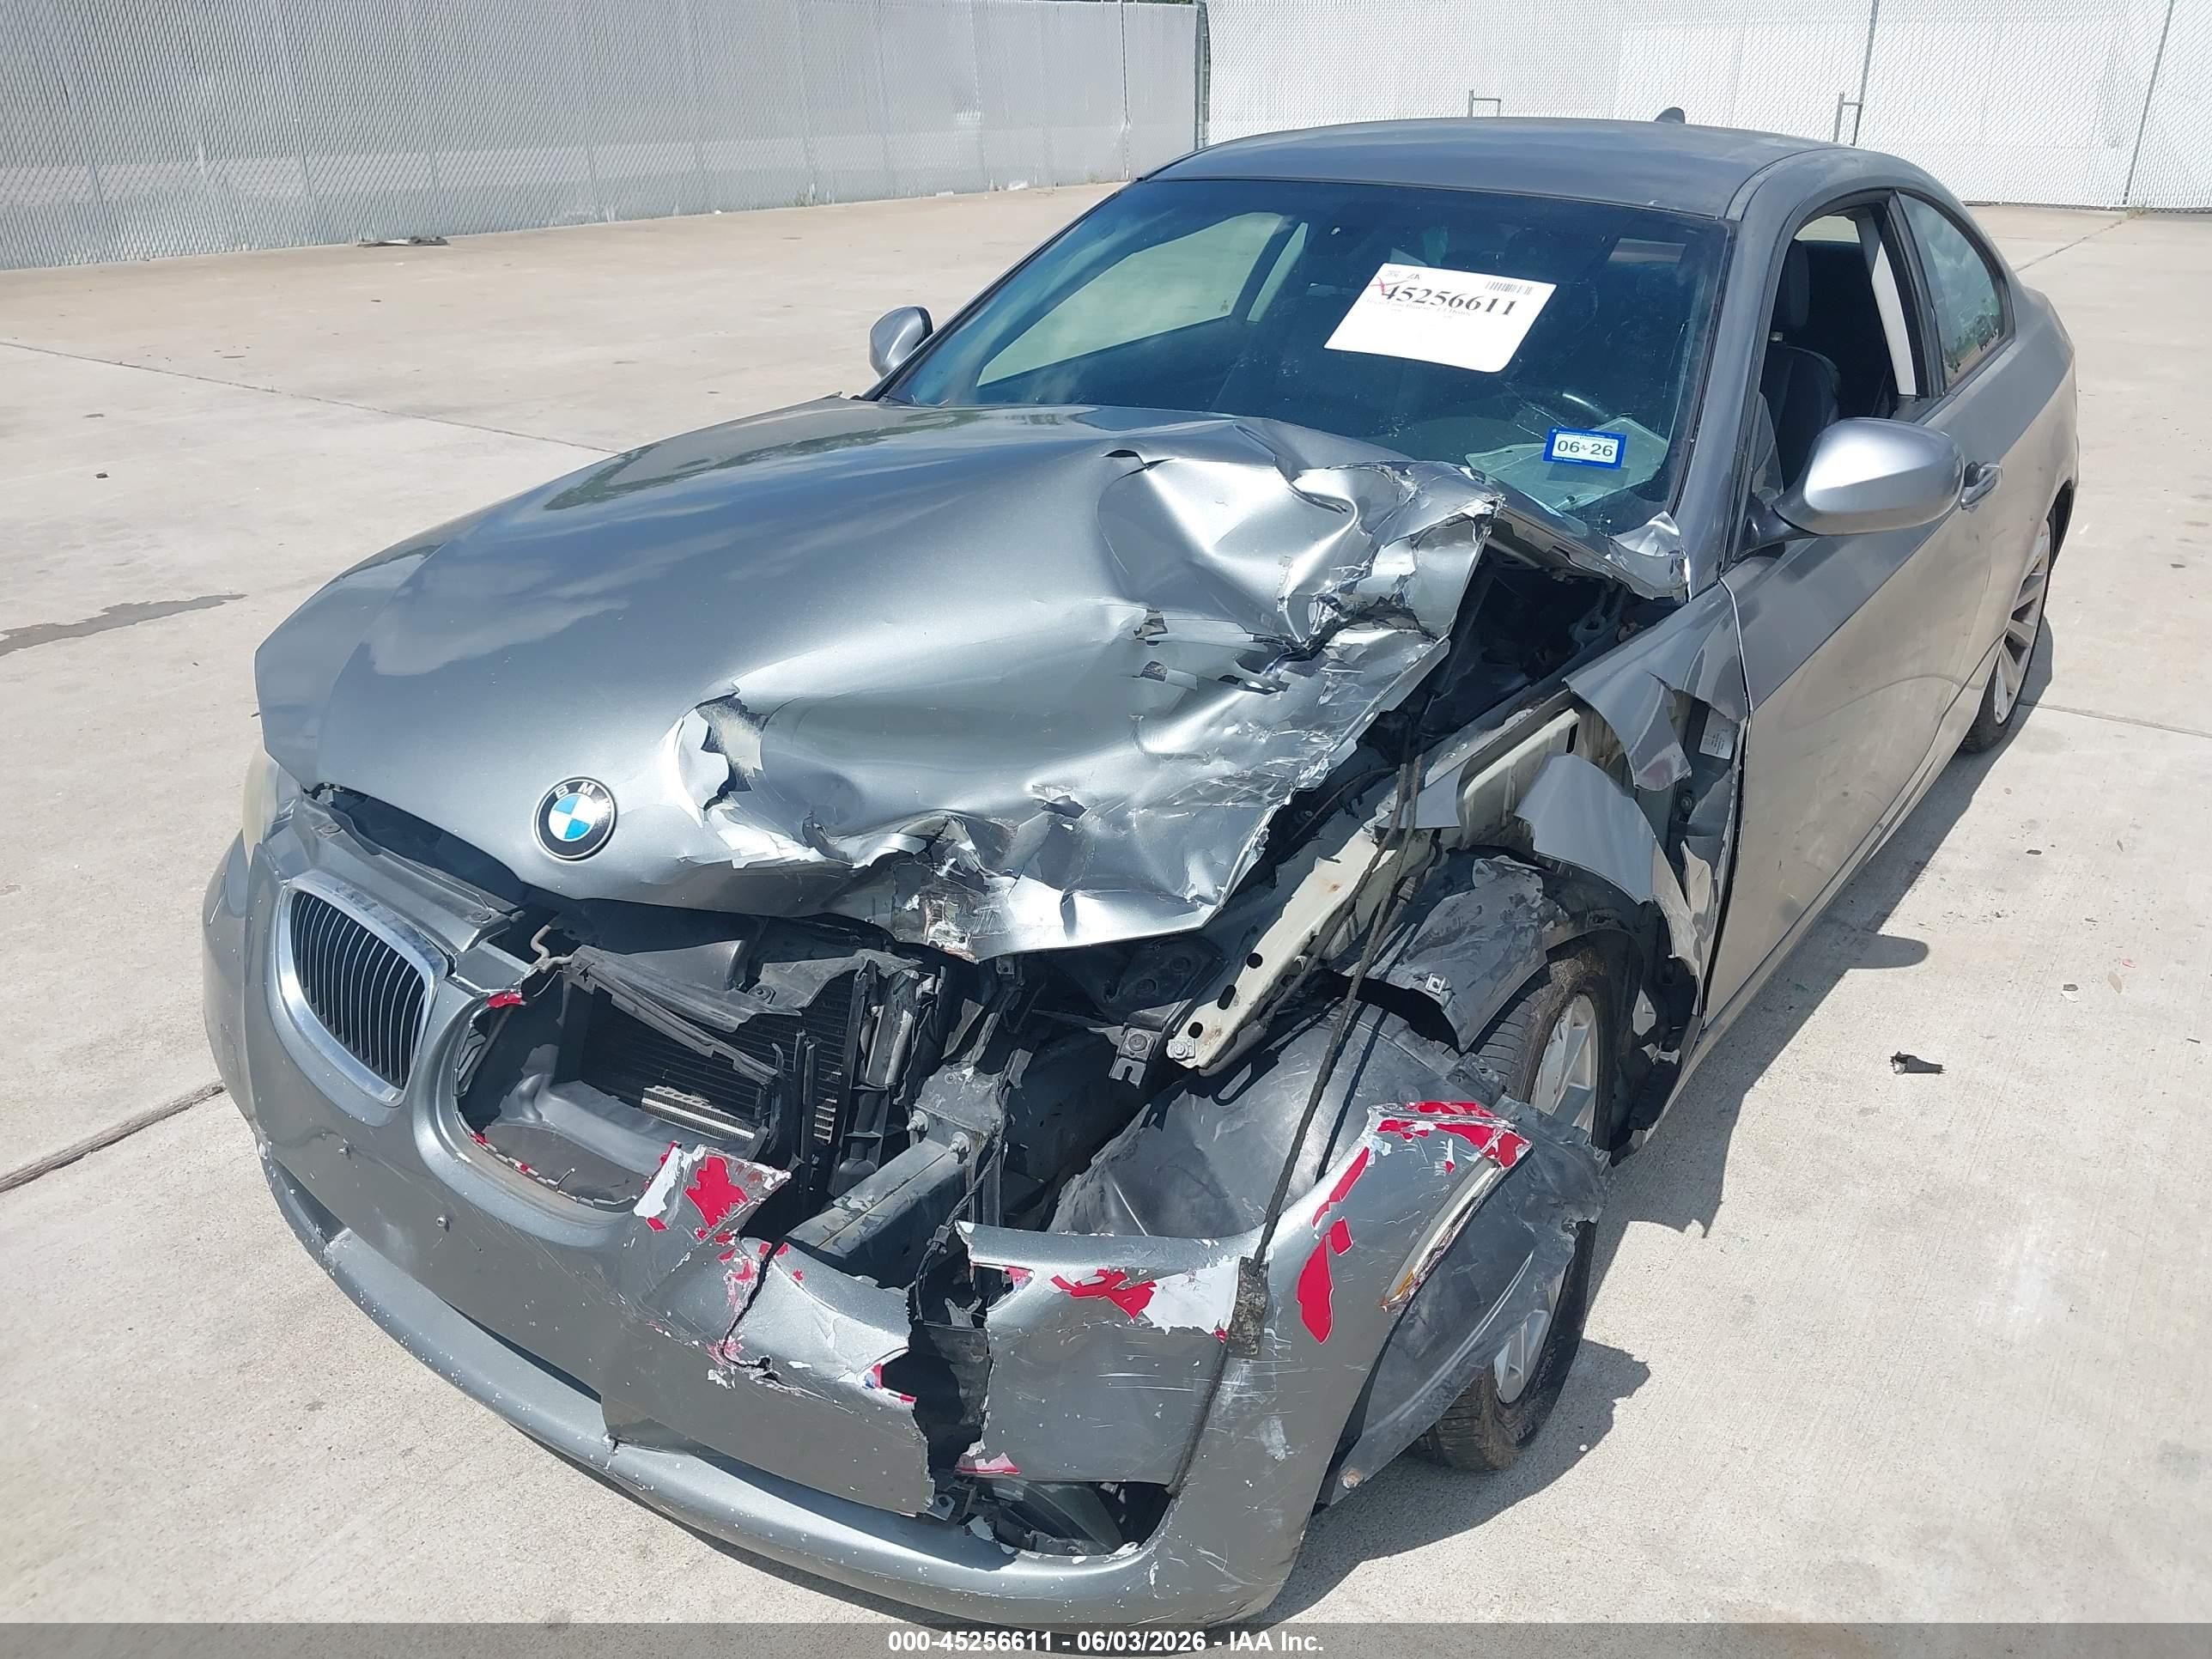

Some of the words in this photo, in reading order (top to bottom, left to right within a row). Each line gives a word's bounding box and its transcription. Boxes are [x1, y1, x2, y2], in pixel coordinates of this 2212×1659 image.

[1382, 285, 1516, 316] 45256611
[1558, 441, 1580, 453] 06
[1589, 444, 1613, 457] 26
